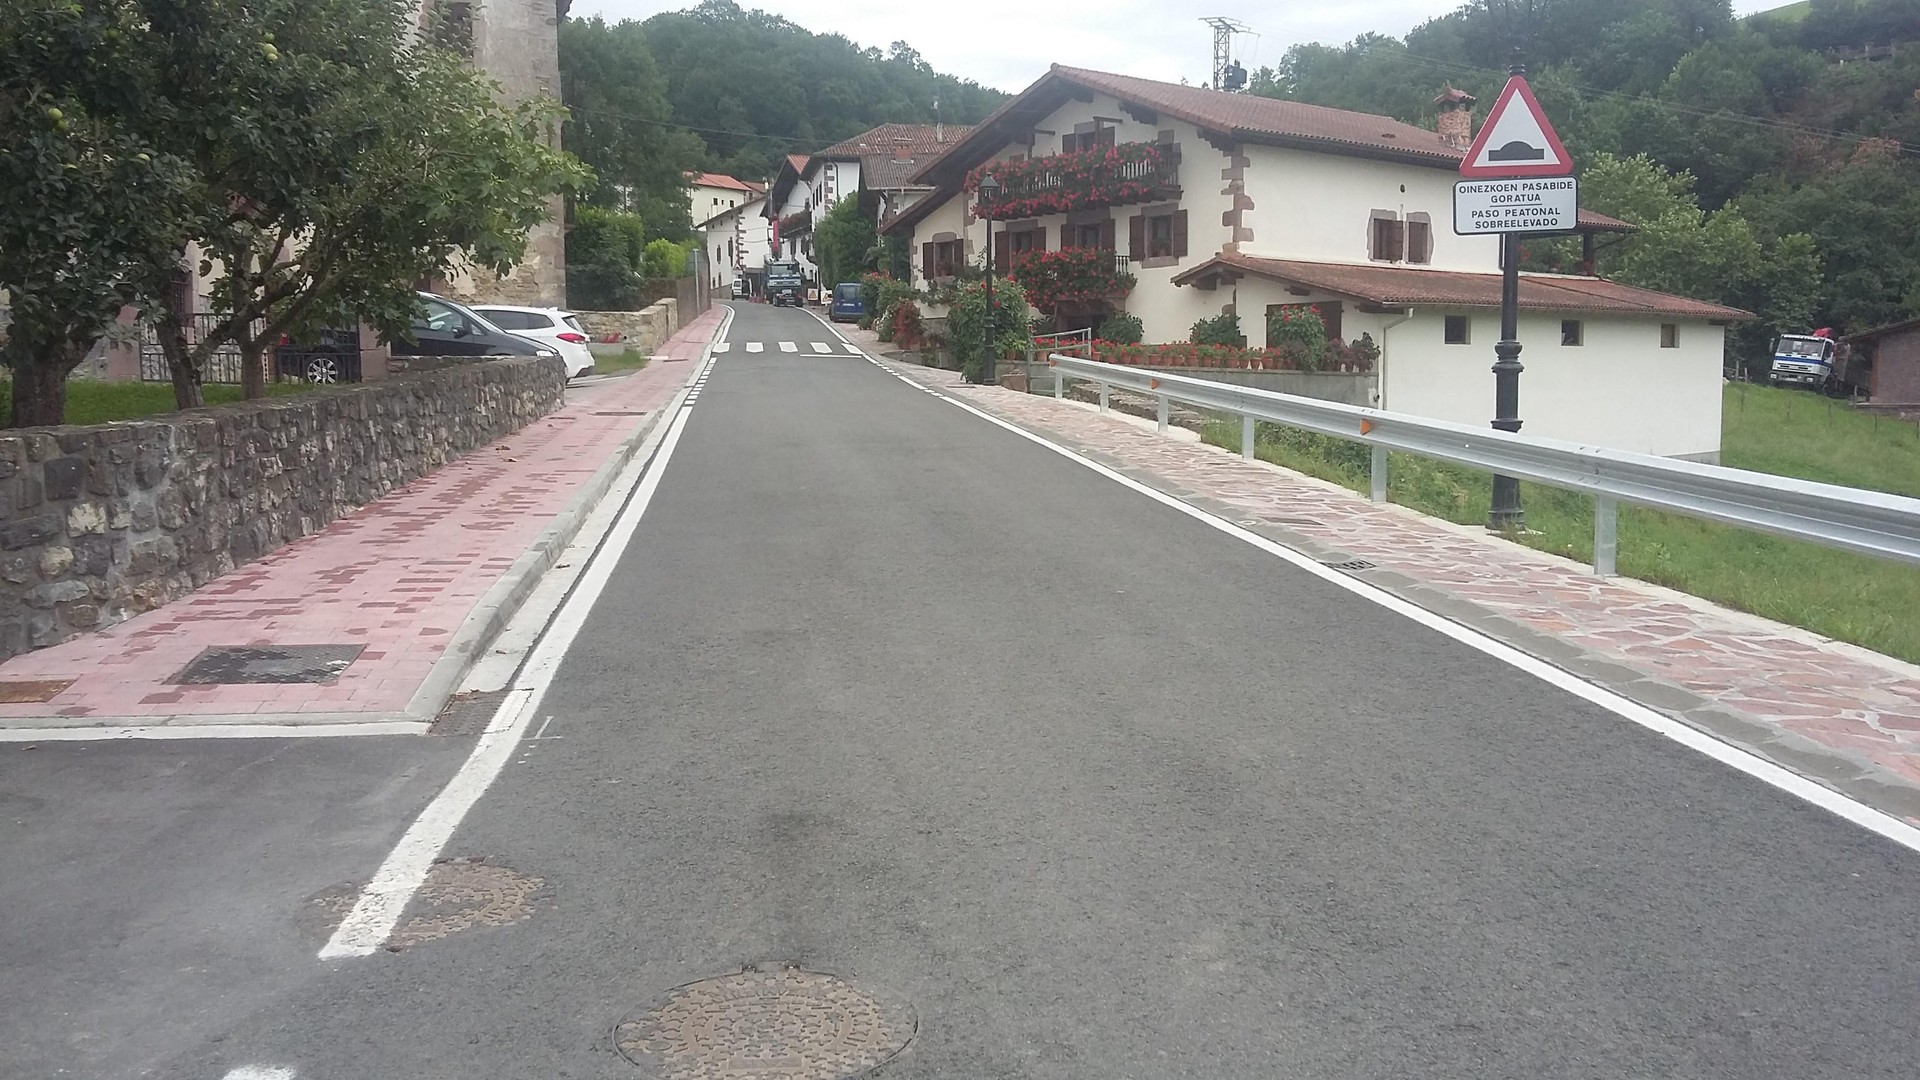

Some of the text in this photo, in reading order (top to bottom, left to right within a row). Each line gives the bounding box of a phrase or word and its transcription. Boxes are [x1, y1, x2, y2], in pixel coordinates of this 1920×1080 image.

[1459, 181, 1573, 194] OINEZKOEN PASABIDE
[1490, 193, 1541, 203] GORATUA
[1471, 207, 1561, 218] PASO PEATONAL
[1475, 218, 1558, 229] SOBREELEVADO
